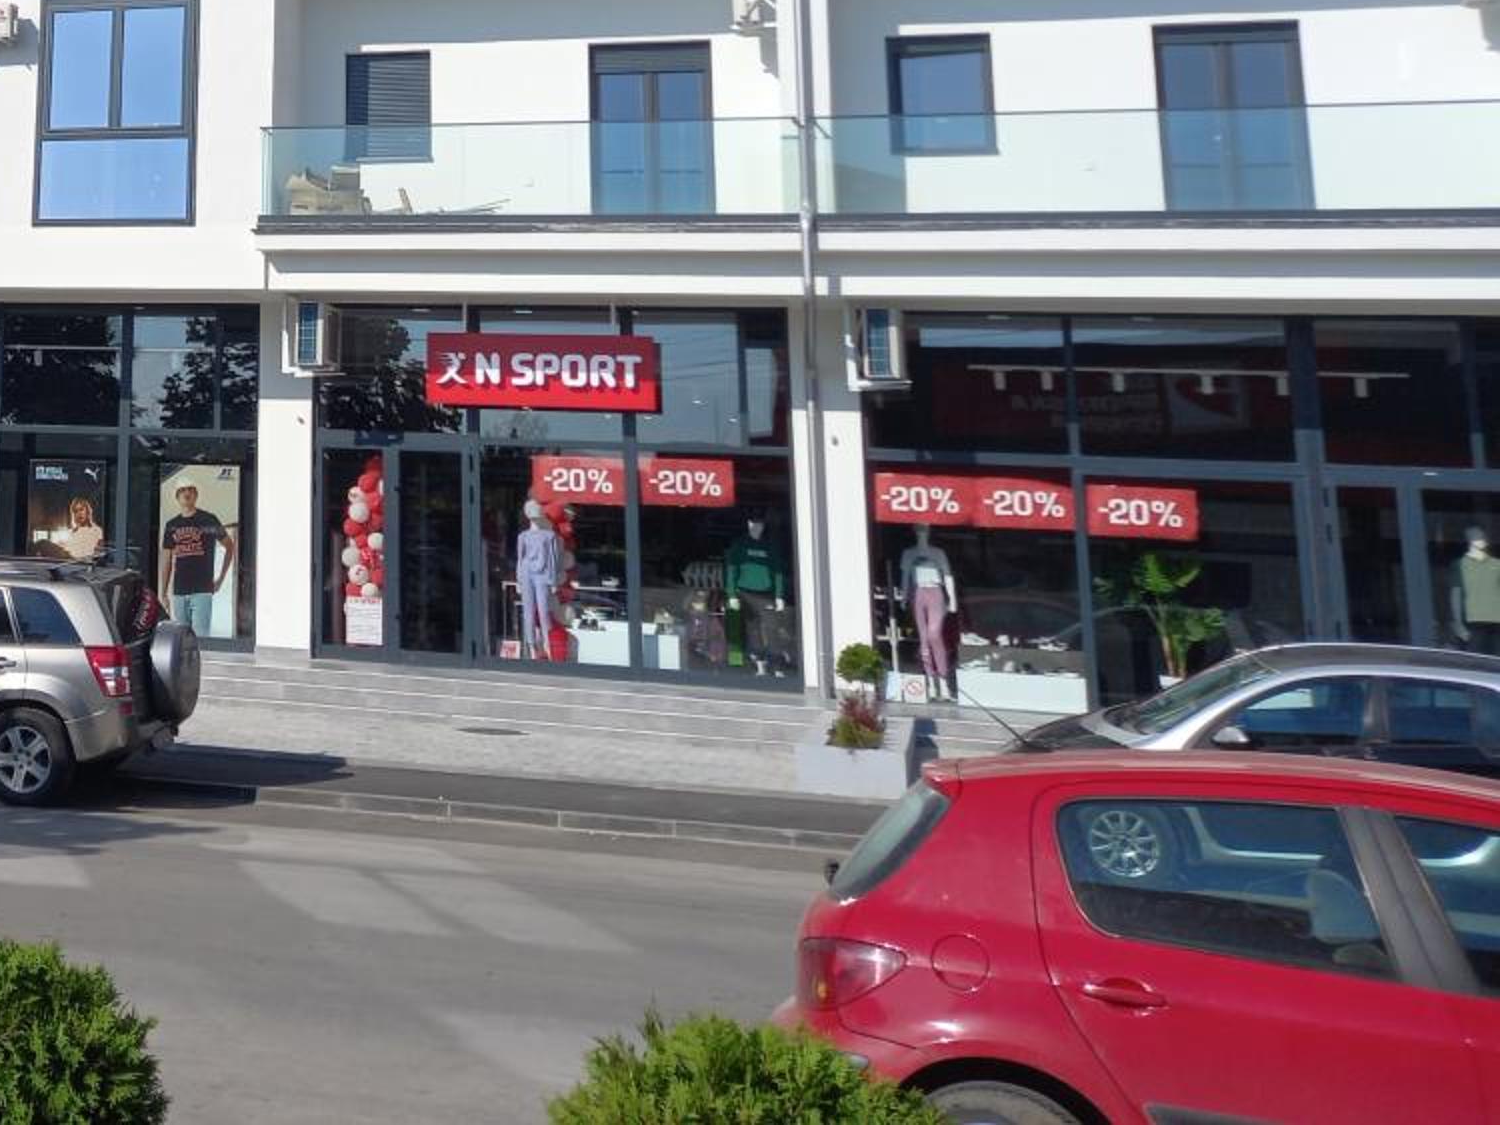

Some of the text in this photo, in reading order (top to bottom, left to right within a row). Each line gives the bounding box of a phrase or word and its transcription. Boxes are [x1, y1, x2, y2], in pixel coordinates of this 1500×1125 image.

[474, 351, 643, 390] N SPORT
[543, 467, 614, 495] -20%
[649, 468, 723, 497] -20%
[880, 485, 960, 515] -20%
[983, 488, 1066, 519] -20%
[1097, 498, 1184, 529] -20%
